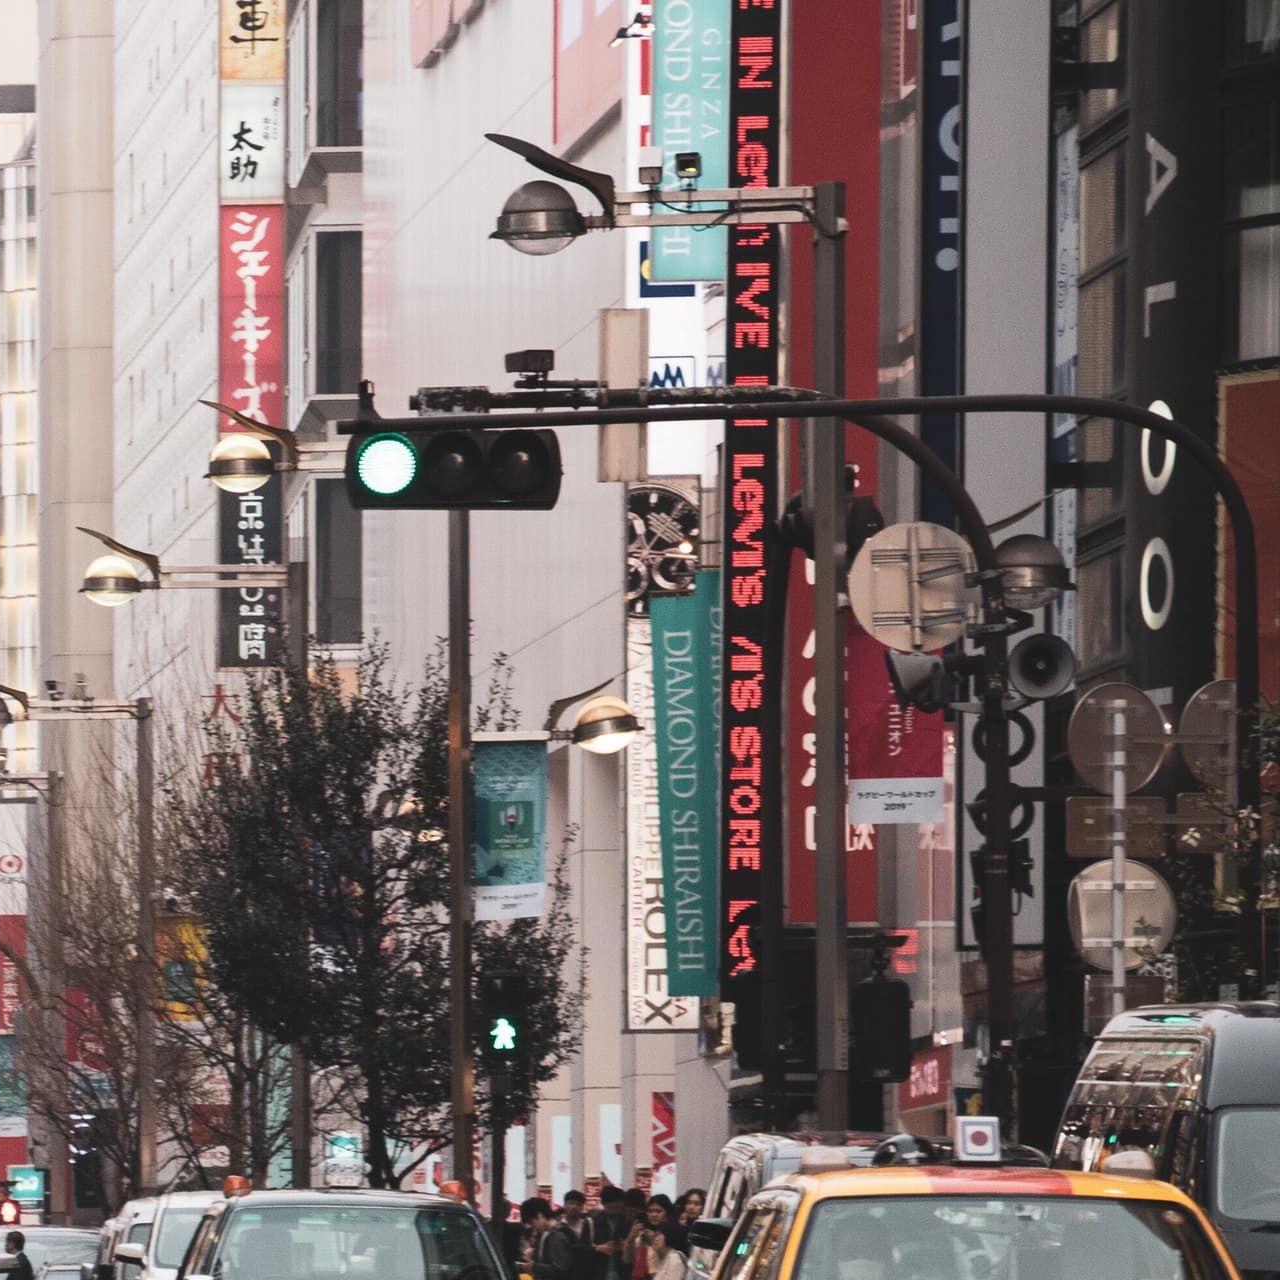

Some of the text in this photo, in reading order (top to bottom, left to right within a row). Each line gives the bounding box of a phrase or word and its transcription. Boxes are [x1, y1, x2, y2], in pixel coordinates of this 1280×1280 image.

[700, 28, 721, 139] GINZA
[738, 36, 773, 88] IN
[229, 120, 265, 183] 太助
[229, 211, 275, 427] シェーキーズ
[663, 630, 698, 799] DIAMOND
[729, 726, 762, 870] STORE
[631, 855, 643, 928] CARTIER
[644, 877, 672, 1026] ROLEX
[671, 809, 705, 971] SHIRAISHI
